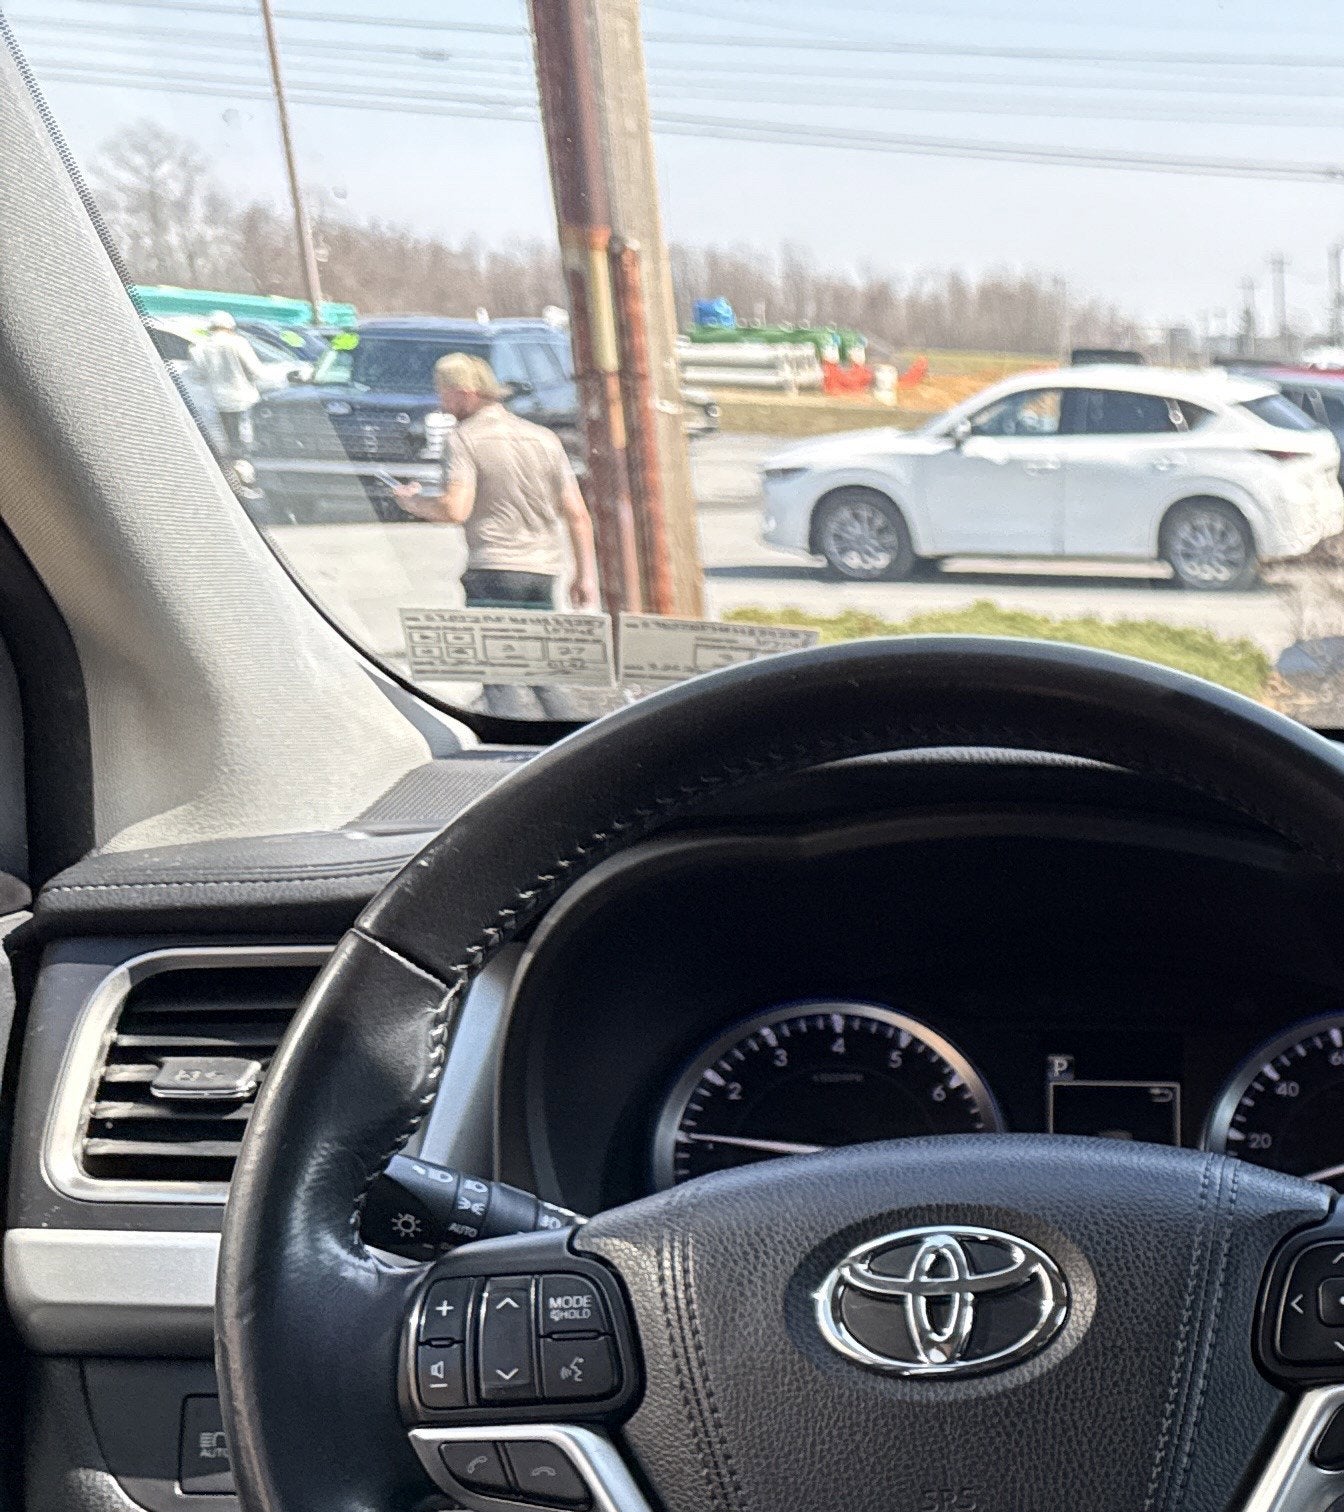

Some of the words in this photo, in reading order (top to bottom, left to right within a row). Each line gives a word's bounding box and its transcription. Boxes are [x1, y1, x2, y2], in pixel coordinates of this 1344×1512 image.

[832, 1038, 846, 1054] 4
[773, 1050, 788, 1067] 3
[887, 1051, 902, 1069] 5
[1052, 1059, 1068, 1077] P
[727, 1083, 743, 1100] 2
[932, 1085, 947, 1101] 6
[1275, 1081, 1300, 1097] 40
[1248, 1133, 1272, 1149] 20
[449, 1221, 478, 1238] AUTO
[549, 1295, 593, 1310] MODE
[560, 1309, 592, 1320] HOLD
[921, 1488, 977, 1512] SRS
